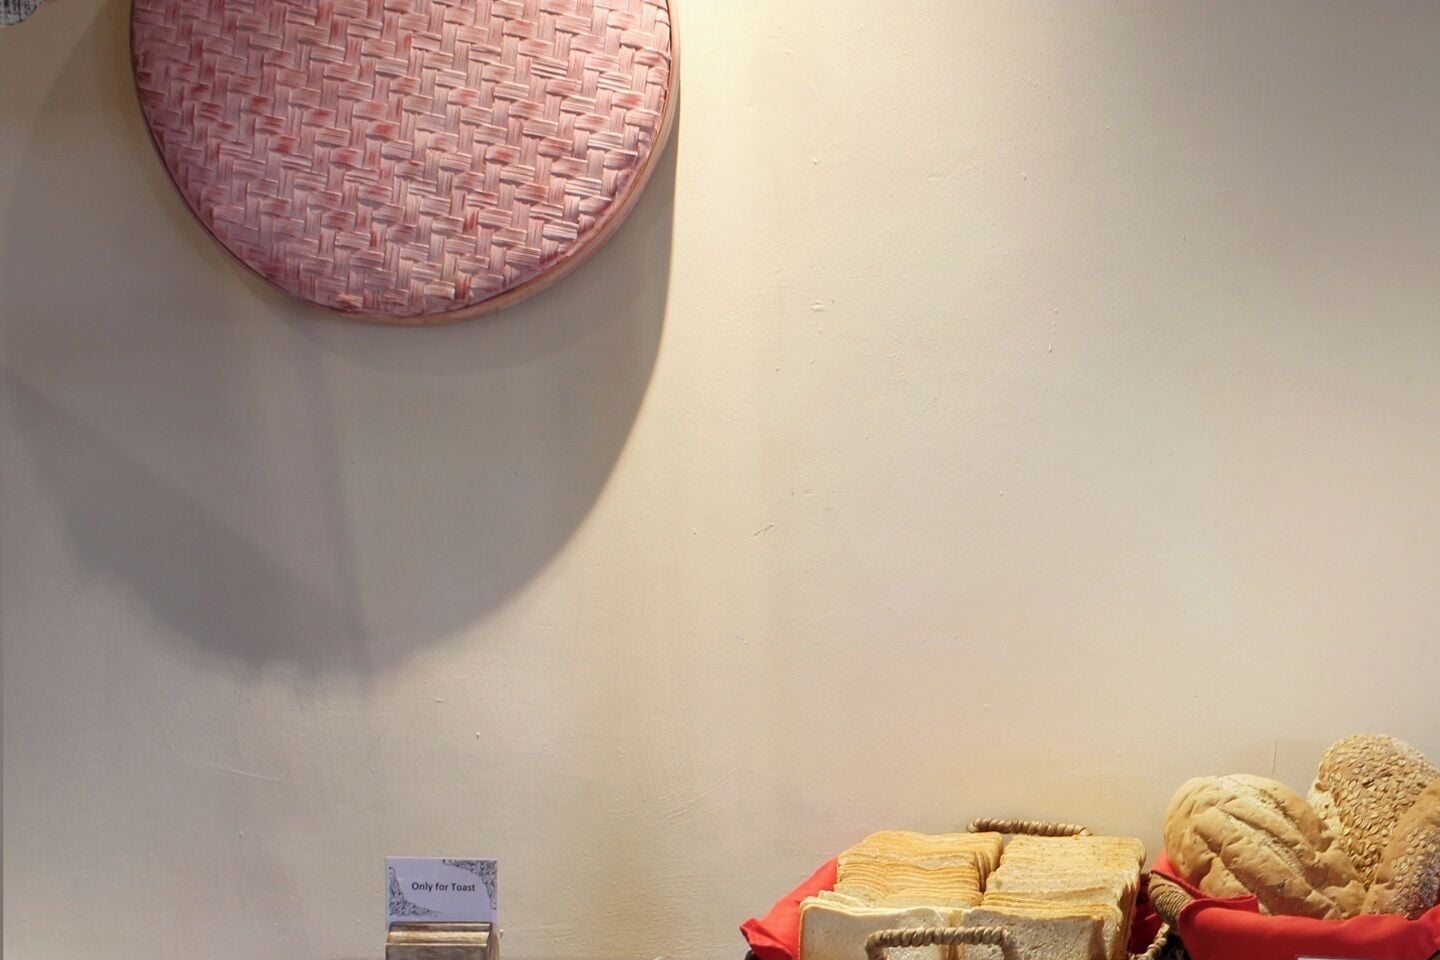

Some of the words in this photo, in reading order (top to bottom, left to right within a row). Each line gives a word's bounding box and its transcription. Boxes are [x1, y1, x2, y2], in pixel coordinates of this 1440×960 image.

[411, 882, 433, 892] Only
[435, 882, 448, 891] for
[451, 883, 476, 892] Toast
